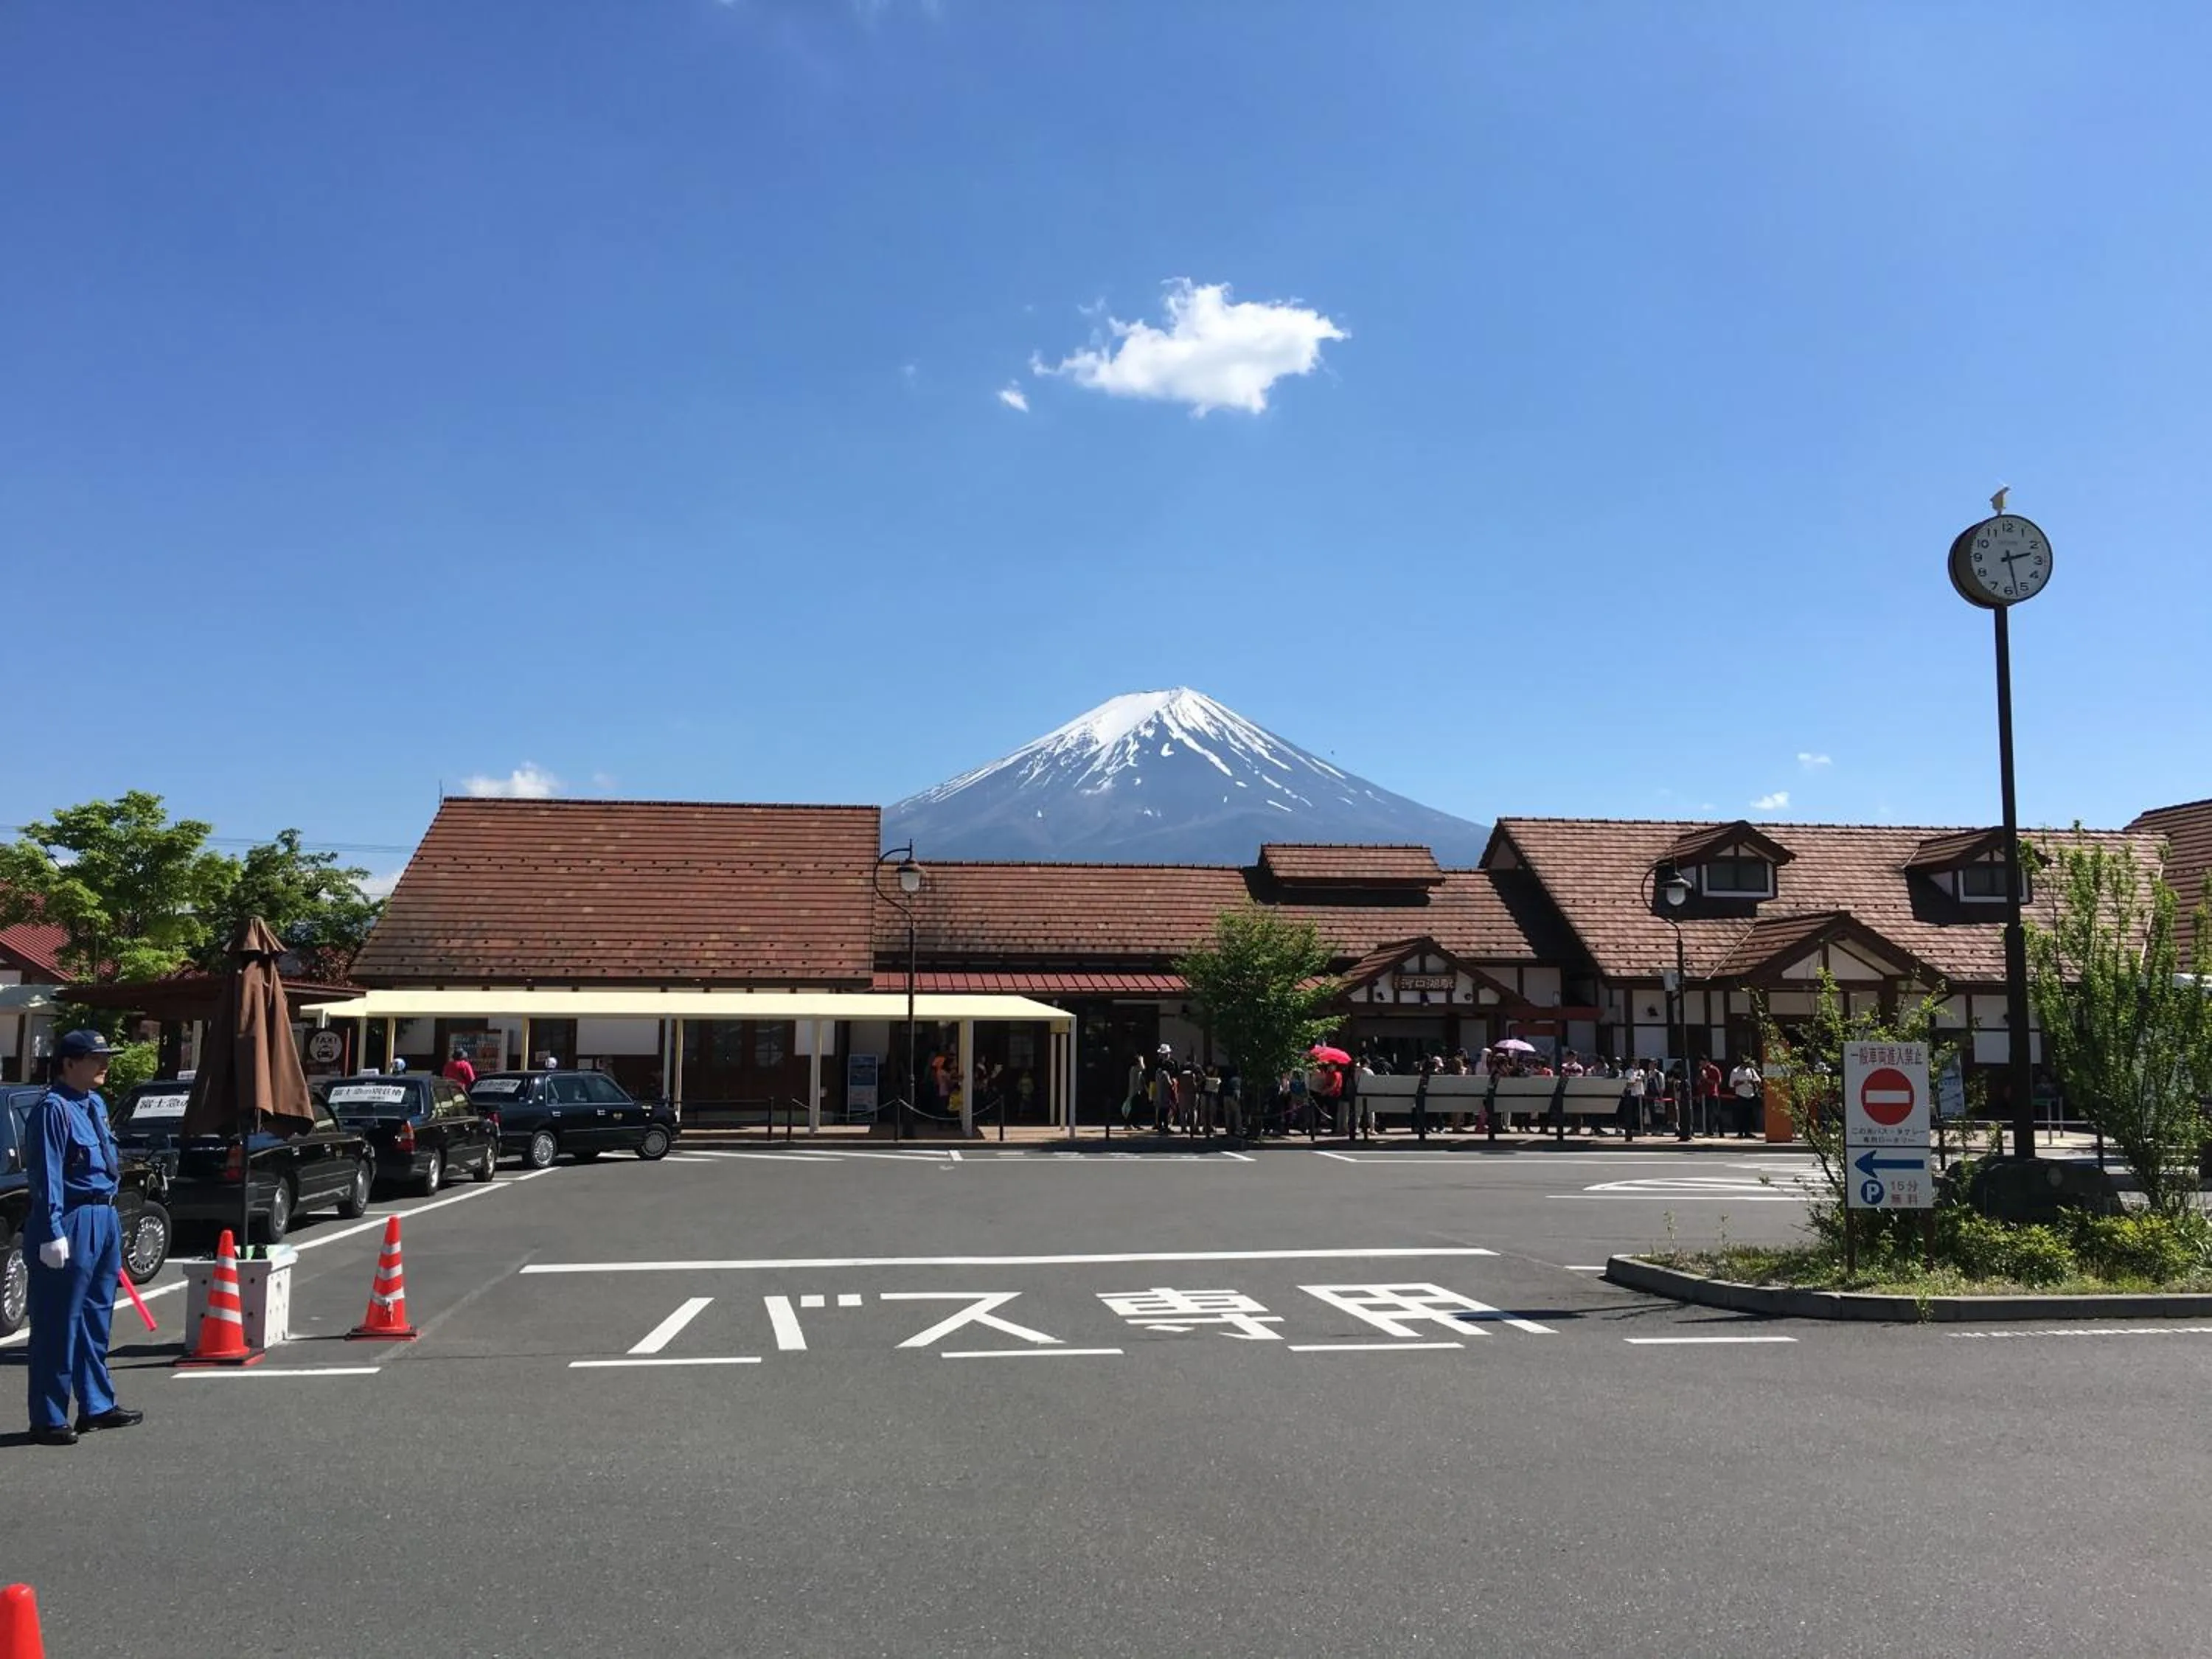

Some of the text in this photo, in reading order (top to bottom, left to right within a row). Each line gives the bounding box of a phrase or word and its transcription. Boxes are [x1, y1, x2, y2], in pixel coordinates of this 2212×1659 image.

[1987, 527, 1997, 537] 11
[2002, 523, 2014, 532] 12
[1977, 539, 1989, 549] 10
[2029, 540, 2039, 549] 2
[1974, 553, 1983, 562] 9
[2034, 556, 2042, 565] 3
[1978, 567, 1987, 577] 8
[2029, 571, 2039, 579] 4
[1991, 581, 1999, 590] 7
[2020, 582, 2028, 591] 5
[2004, 586, 2014, 595] 6
[316, 1037, 337, 1045] TAXI
[1850, 1046, 1924, 1065] 一般車両進入禁止
[1866, 1183, 1879, 1202] P
[627, 1282, 1559, 1352] バス専用
